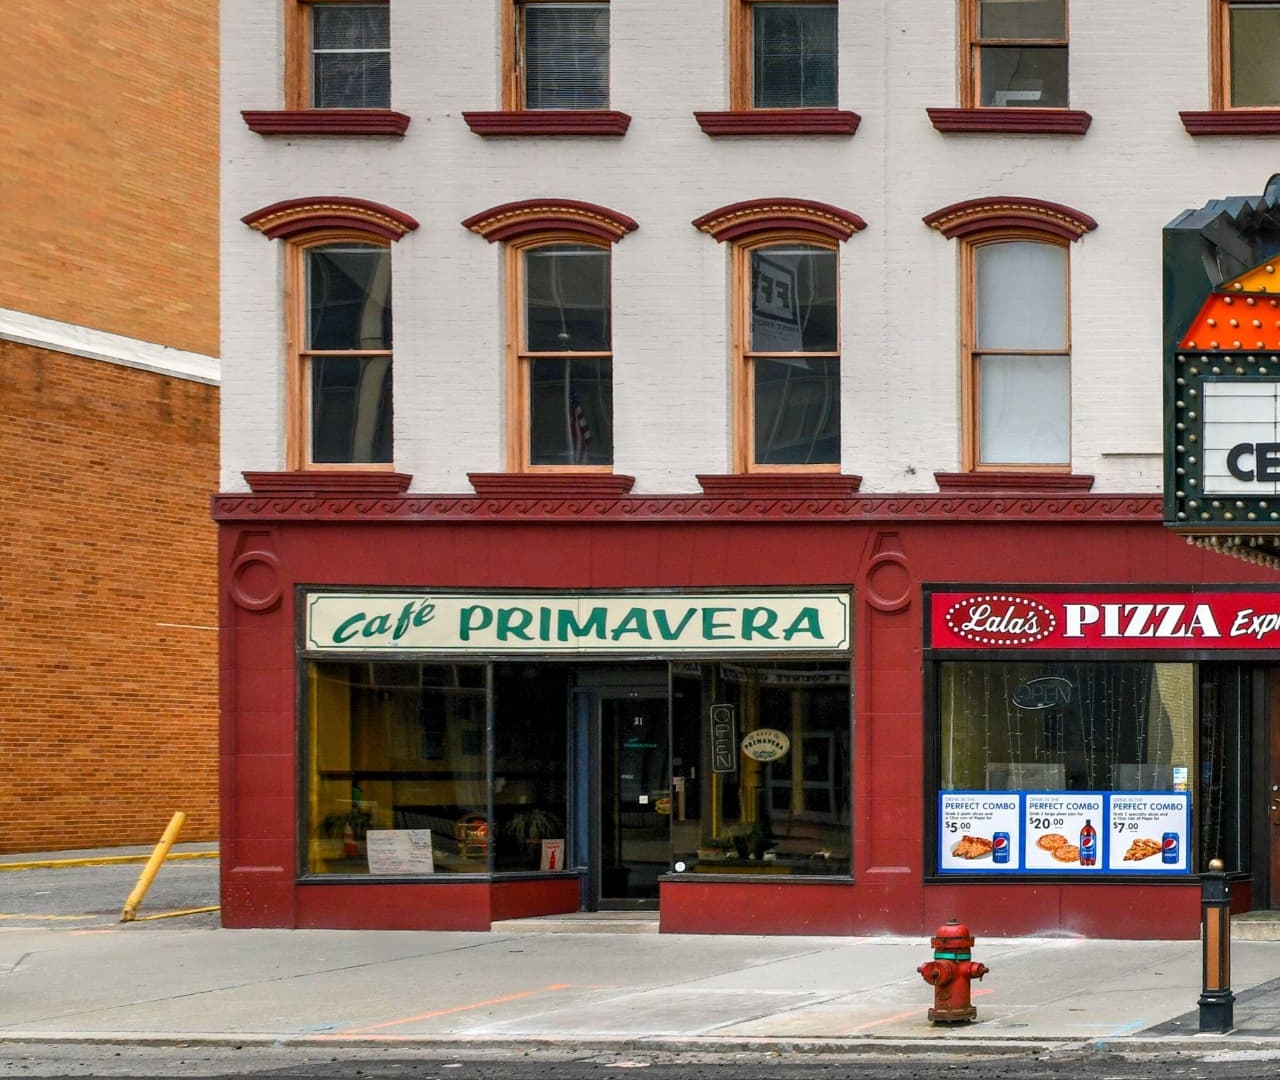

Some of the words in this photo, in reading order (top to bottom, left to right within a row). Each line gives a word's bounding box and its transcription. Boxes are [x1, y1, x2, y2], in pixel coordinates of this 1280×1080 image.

[459, 605, 825, 642] PRIMAVERA
[960, 605, 1042, 636] Lala's
[1062, 603, 1222, 638] PIZZA
[1012, 681, 1073, 703] OPEN
[714, 707, 731, 769] OPEN
[744, 738, 784, 751] PRIMAVERA
[945, 802, 979, 810] PERFECT
[982, 802, 1016, 810] COMBO
[1029, 802, 1064, 810] PERFECT
[1066, 802, 1100, 810] COMBO
[1150, 803, 1183, 811] COMBO
[945, 821, 971, 833] $5.00
[1029, 817, 1064, 830] $20.00
[1113, 822, 1139, 833] $7.00
